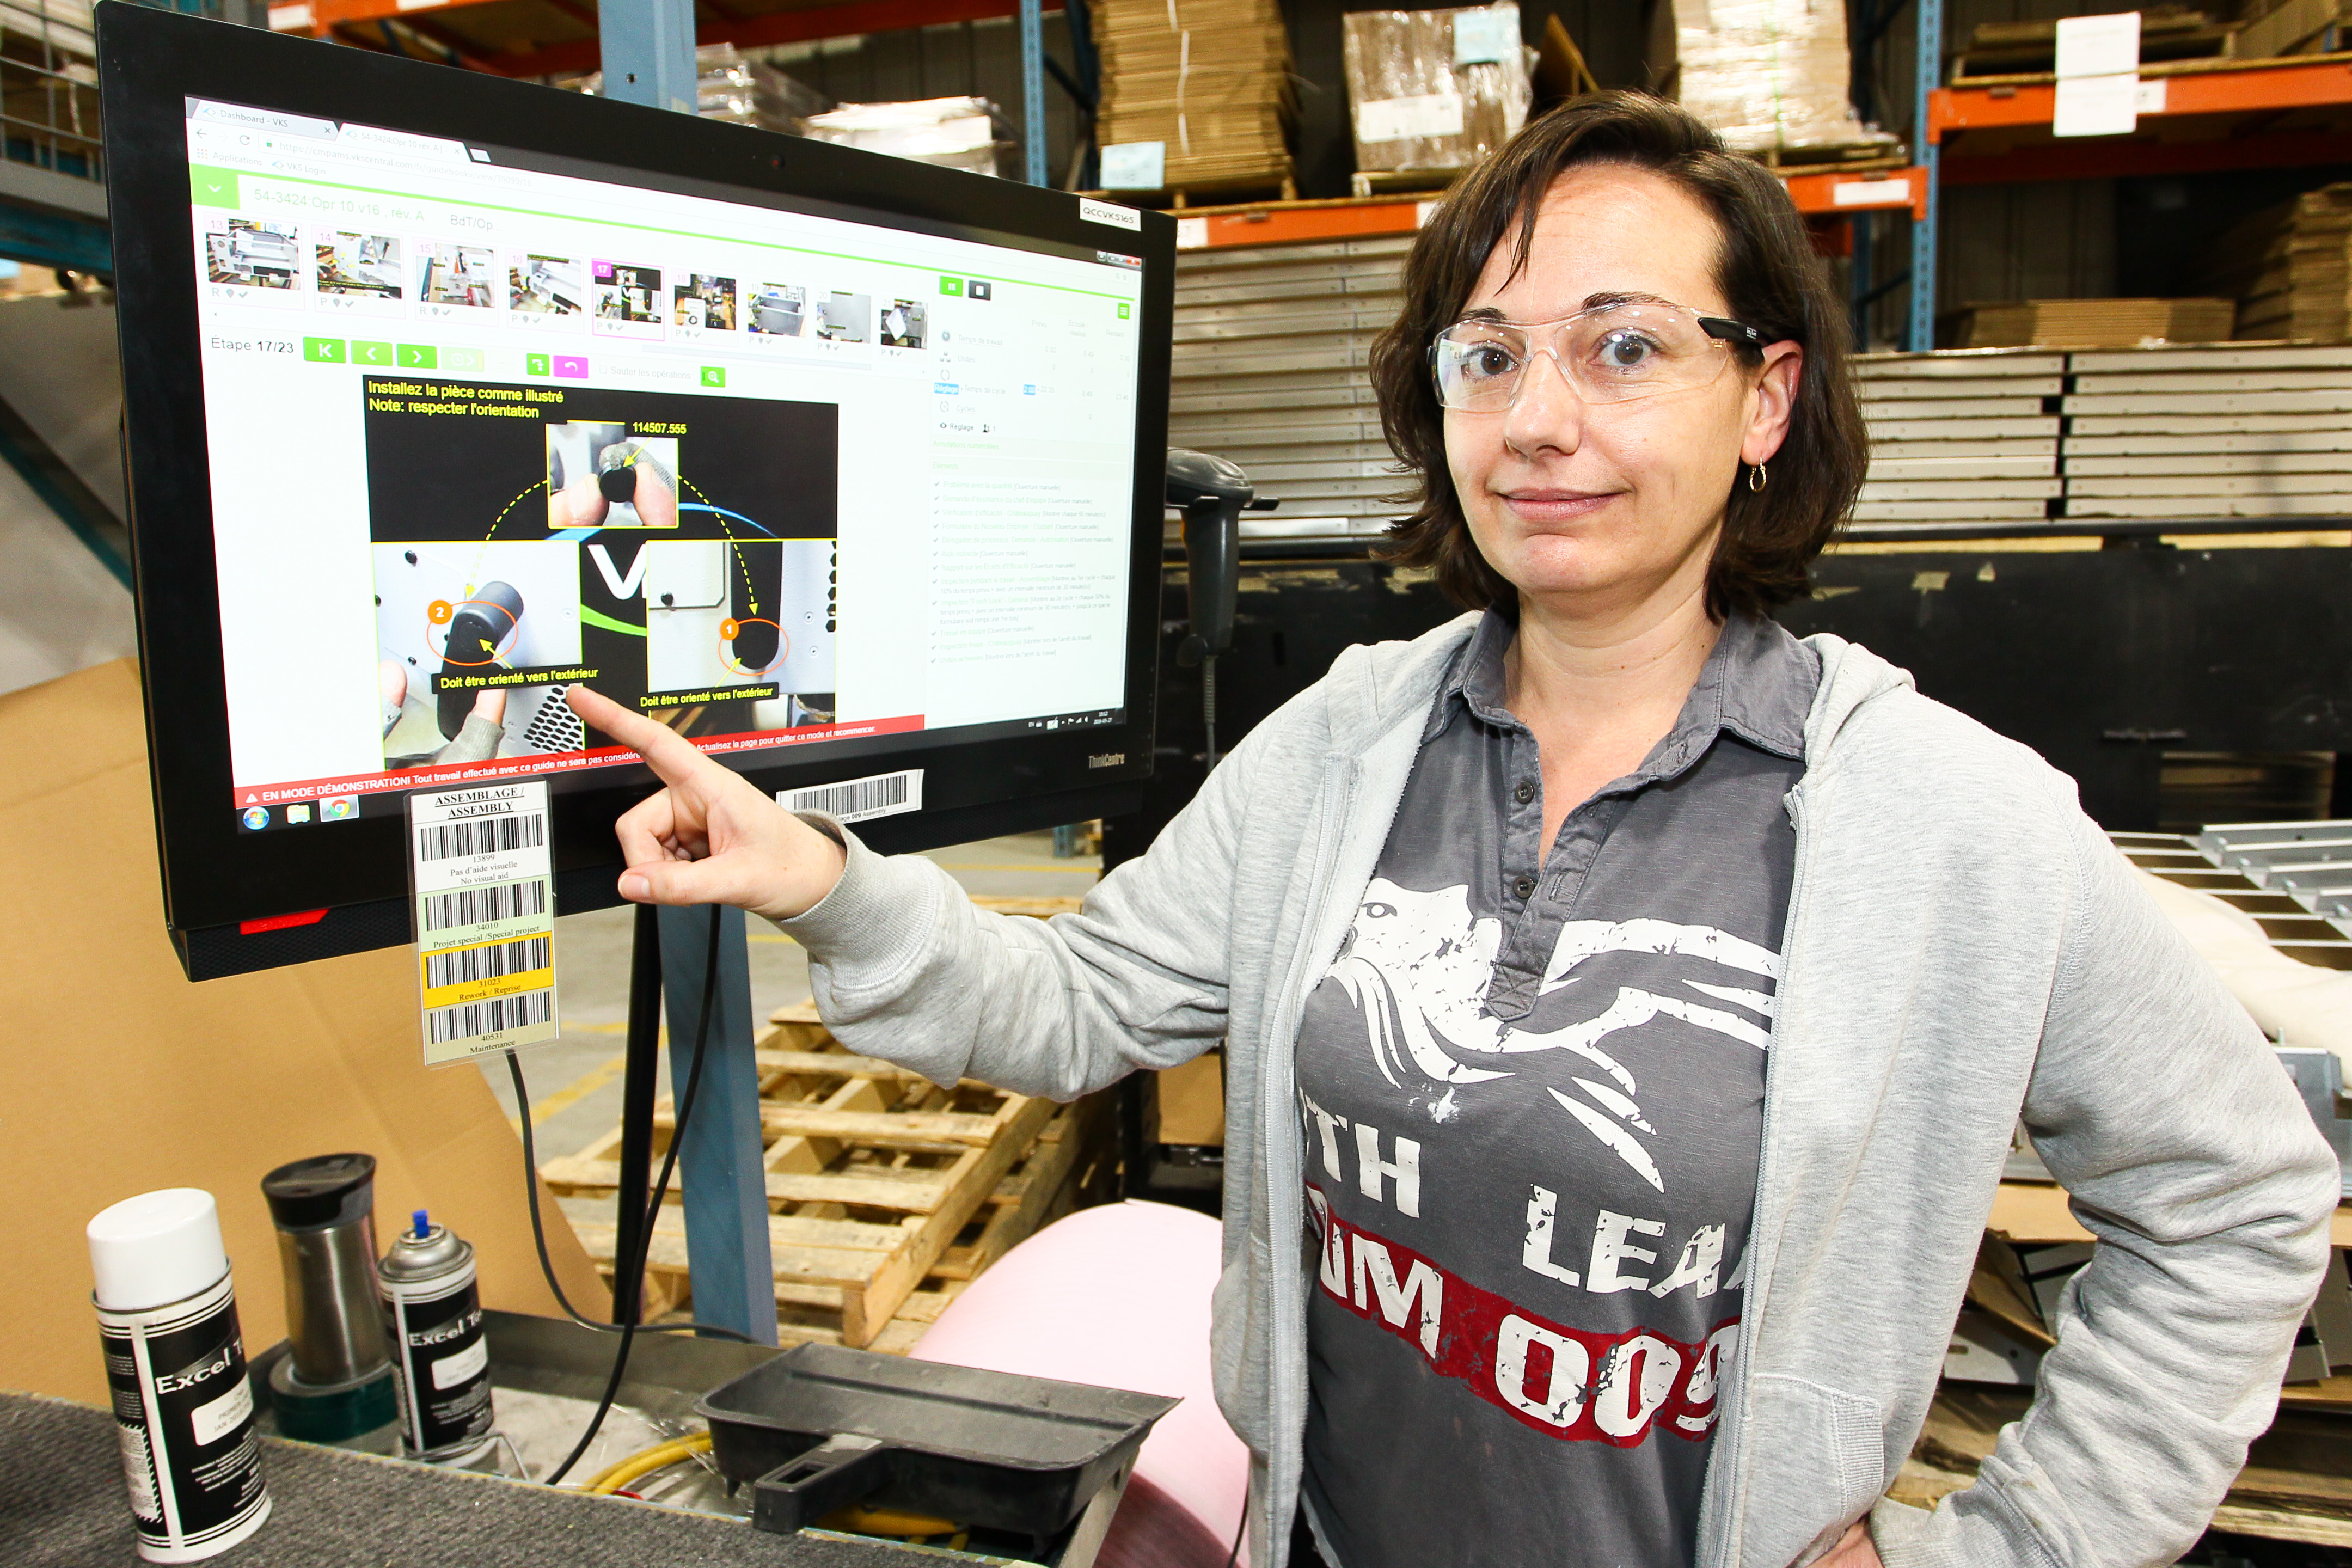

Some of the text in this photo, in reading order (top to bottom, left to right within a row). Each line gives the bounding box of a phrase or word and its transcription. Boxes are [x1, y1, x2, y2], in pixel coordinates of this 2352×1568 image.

[220, 110, 265, 124] Dashboard
[273, 118, 288, 127] VKS
[213, 152, 262, 167] Applications
[287, 162, 326, 175] VKS Login
[254, 189, 336, 210] 54-3424:Opr
[340, 200, 354, 212] 10
[358, 203, 380, 216] v16
[391, 207, 412, 220] rév.
[415, 210, 424, 222] A
[1083, 207, 1134, 223] QCCVKS165
[210, 220, 223, 230] 13
[319, 232, 331, 242] 14
[420, 243, 431, 254] 15
[512, 255, 523, 264] 16
[597, 265, 608, 273] 17
[677, 274, 687, 283] 18
[751, 283, 759, 291] 19
[212, 288, 220, 298] R
[320, 297, 327, 307] P
[883, 299, 890, 308] 21
[420, 305, 427, 315] R
[512, 314, 518, 323] P
[597, 322, 603, 330] P
[675, 329, 681, 337] P
[958, 334, 976, 344] Temps
[211, 336, 294, 354] Étape 17/23
[957, 354, 976, 363] Unités
[610, 366, 691, 380] Sauter les opérations
[368, 381, 564, 403] Installez la pièce comme illustré
[935, 383, 959, 394] Réglage
[965, 384, 982, 394] Temps
[369, 398, 540, 418] Note: respecter l'orientation
[956, 404, 976, 414] Cycles
[633, 421, 687, 435] 114507.555
[950, 422, 974, 432] Réglage
[436, 607, 444, 618] 2
[726, 624, 733, 634] 1
[440, 667, 598, 689] Doit être orienté vers l'extérieur
[640, 688, 773, 707] Doit être orienté vers l'extérieur
[262, 791, 279, 801] EN
[281, 786, 315, 800] MODE
[317, 775, 411, 796] DÉMONSTRATION!
[413, 774, 432, 785] Tout
[434, 770, 461, 782] travail
[462, 767, 497, 780] effectué
[498, 764, 518, 775] avec
[520, 764, 531, 772] ce
[532, 761, 555, 773] guide
[556, 760, 567, 769] ne
[568, 758, 586, 768] sera
[588, 757, 603, 767] pas
[696, 740, 731, 752] Actualisez
[732, 740, 739, 748] la
[740, 739, 758, 749] page
[758, 738, 774, 748] pour
[775, 734, 796, 745] quitter
[806, 731, 824, 739] mode
[834, 726, 877, 737] recommencer.
[434, 786, 525, 807] ASSEMBLAGE /
[448, 801, 514, 818] ASSEMBLY
[862, 808, 886, 817] Assembly
[473, 853, 495, 863] 13899
[450, 860, 518, 877] Pas d'aide visuelle
[461, 872, 509, 885] No visual aid
[476, 922, 499, 932] 34010
[433, 926, 540, 950] Projet special /Special project
[479, 978, 501, 988] 31023
[458, 990, 487, 1001] Rework
[493, 983, 521, 996] Reprise
[481, 1032, 504, 1042] 40531
[470, 1040, 516, 1055] Maintenance
[1300, 1087, 1421, 1219] TH
[409, 1319, 464, 1347] Excel
[155, 1347, 231, 1394] Excel
